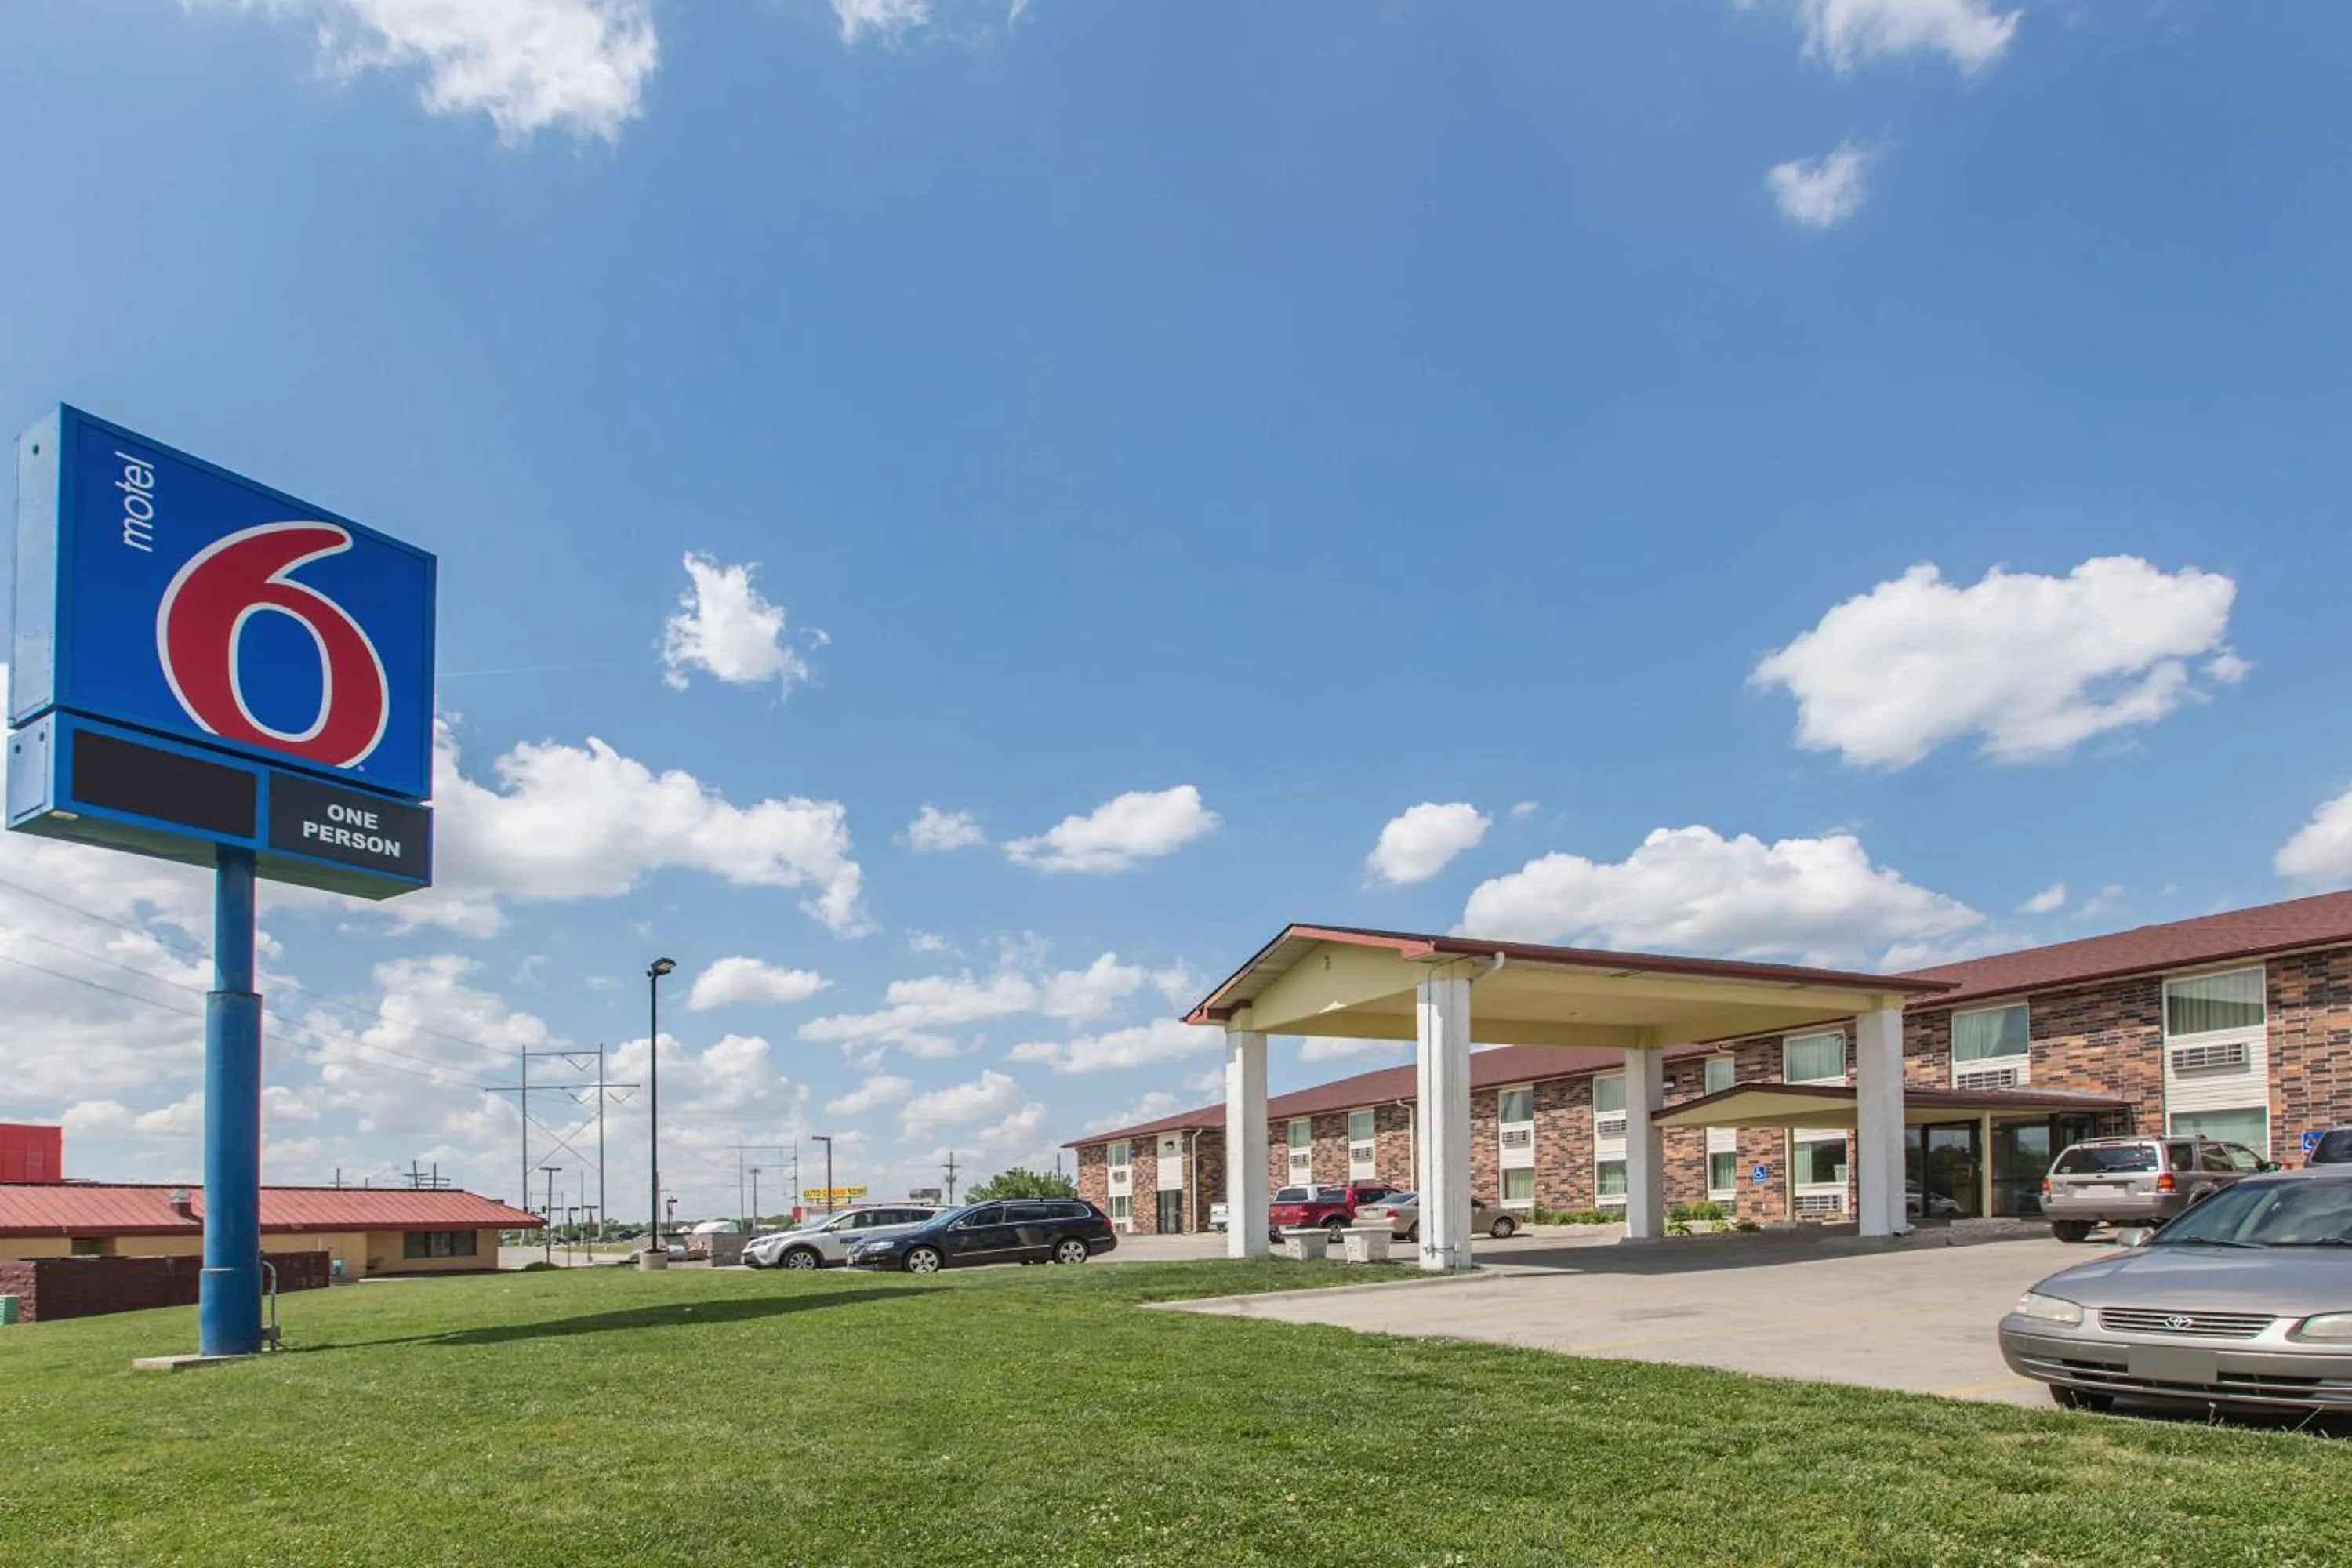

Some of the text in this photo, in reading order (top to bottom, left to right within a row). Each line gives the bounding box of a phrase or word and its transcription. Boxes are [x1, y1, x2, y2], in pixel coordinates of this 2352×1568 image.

[114, 450, 155, 553] motel
[156, 520, 390, 770] 6
[303, 820, 401, 858] PERSON
[327, 804, 379, 830] ONE
